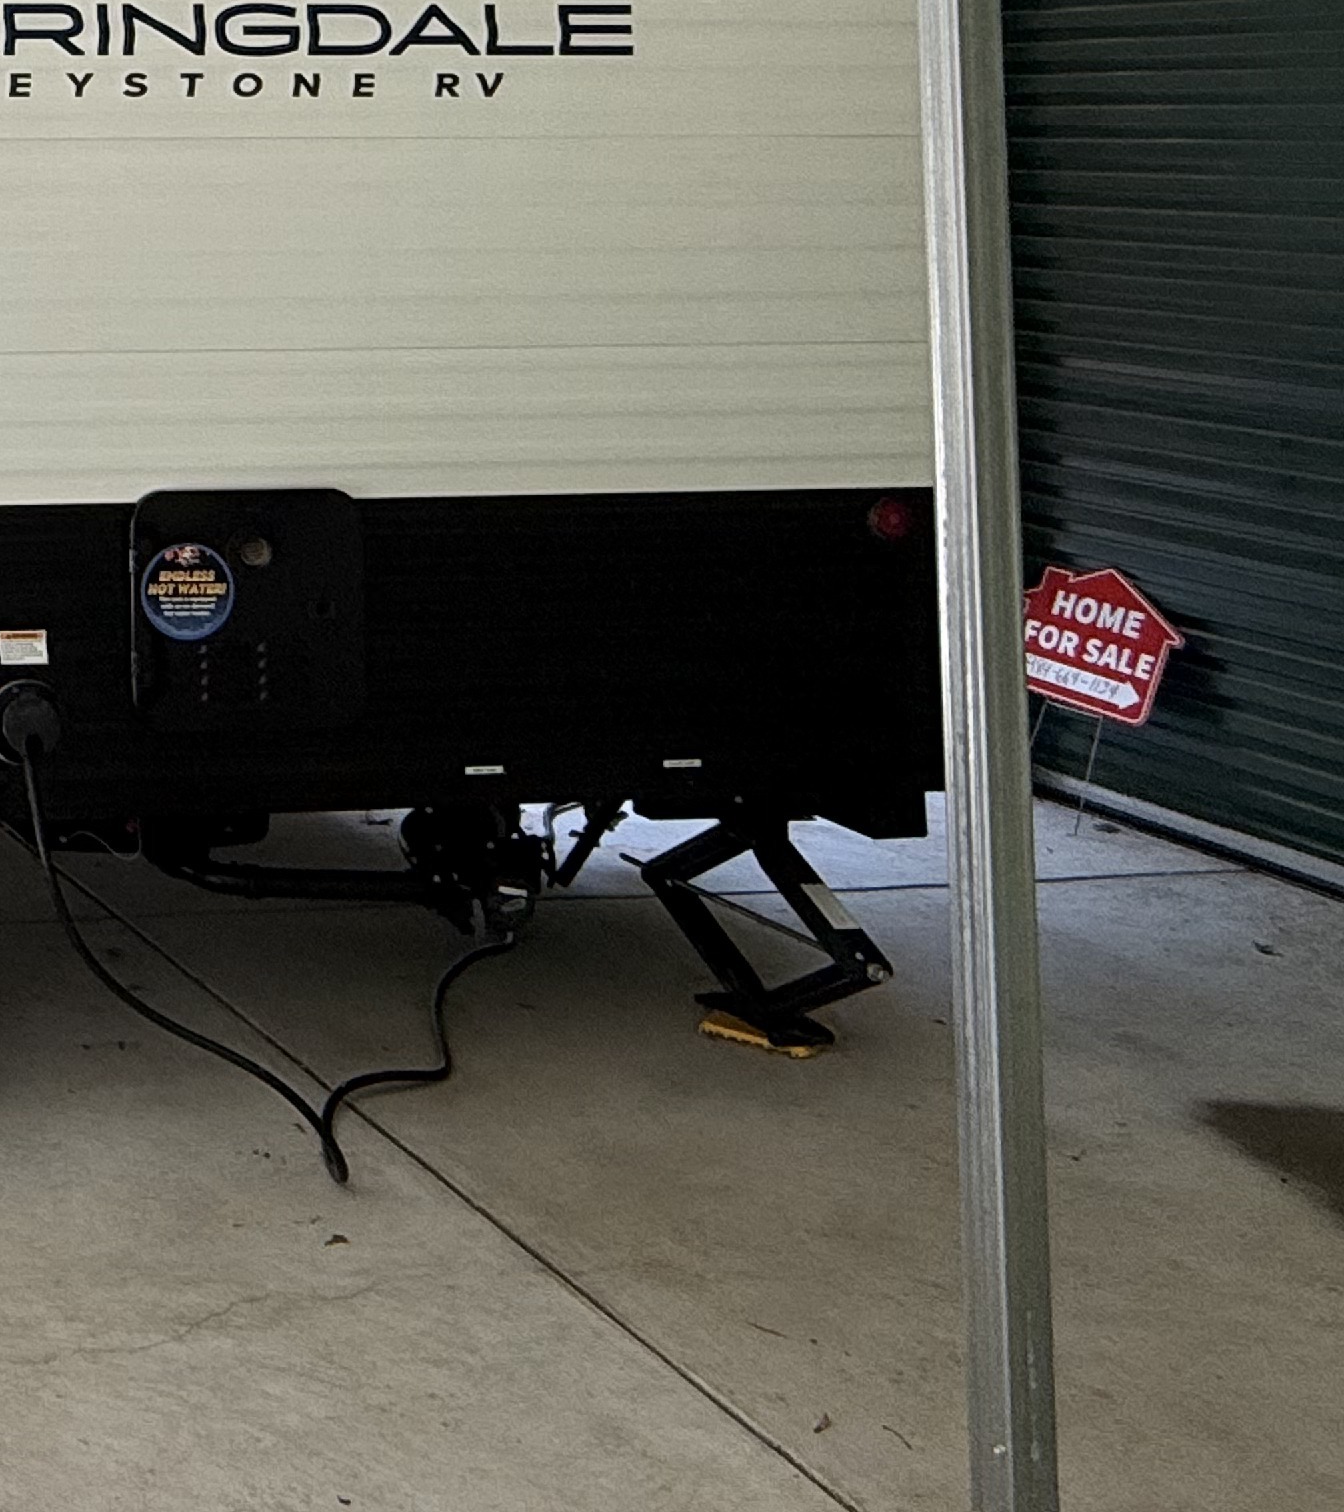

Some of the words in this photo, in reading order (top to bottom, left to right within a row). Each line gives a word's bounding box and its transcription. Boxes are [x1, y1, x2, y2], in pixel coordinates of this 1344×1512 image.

[435, 73, 503, 97] RV
[159, 570, 216, 582] ENDLESS
[147, 582, 176, 596] HOT
[1052, 590, 1146, 639] HOME
[1024, 619, 1080, 656] FOR
[1083, 638, 1156, 680] SALE
